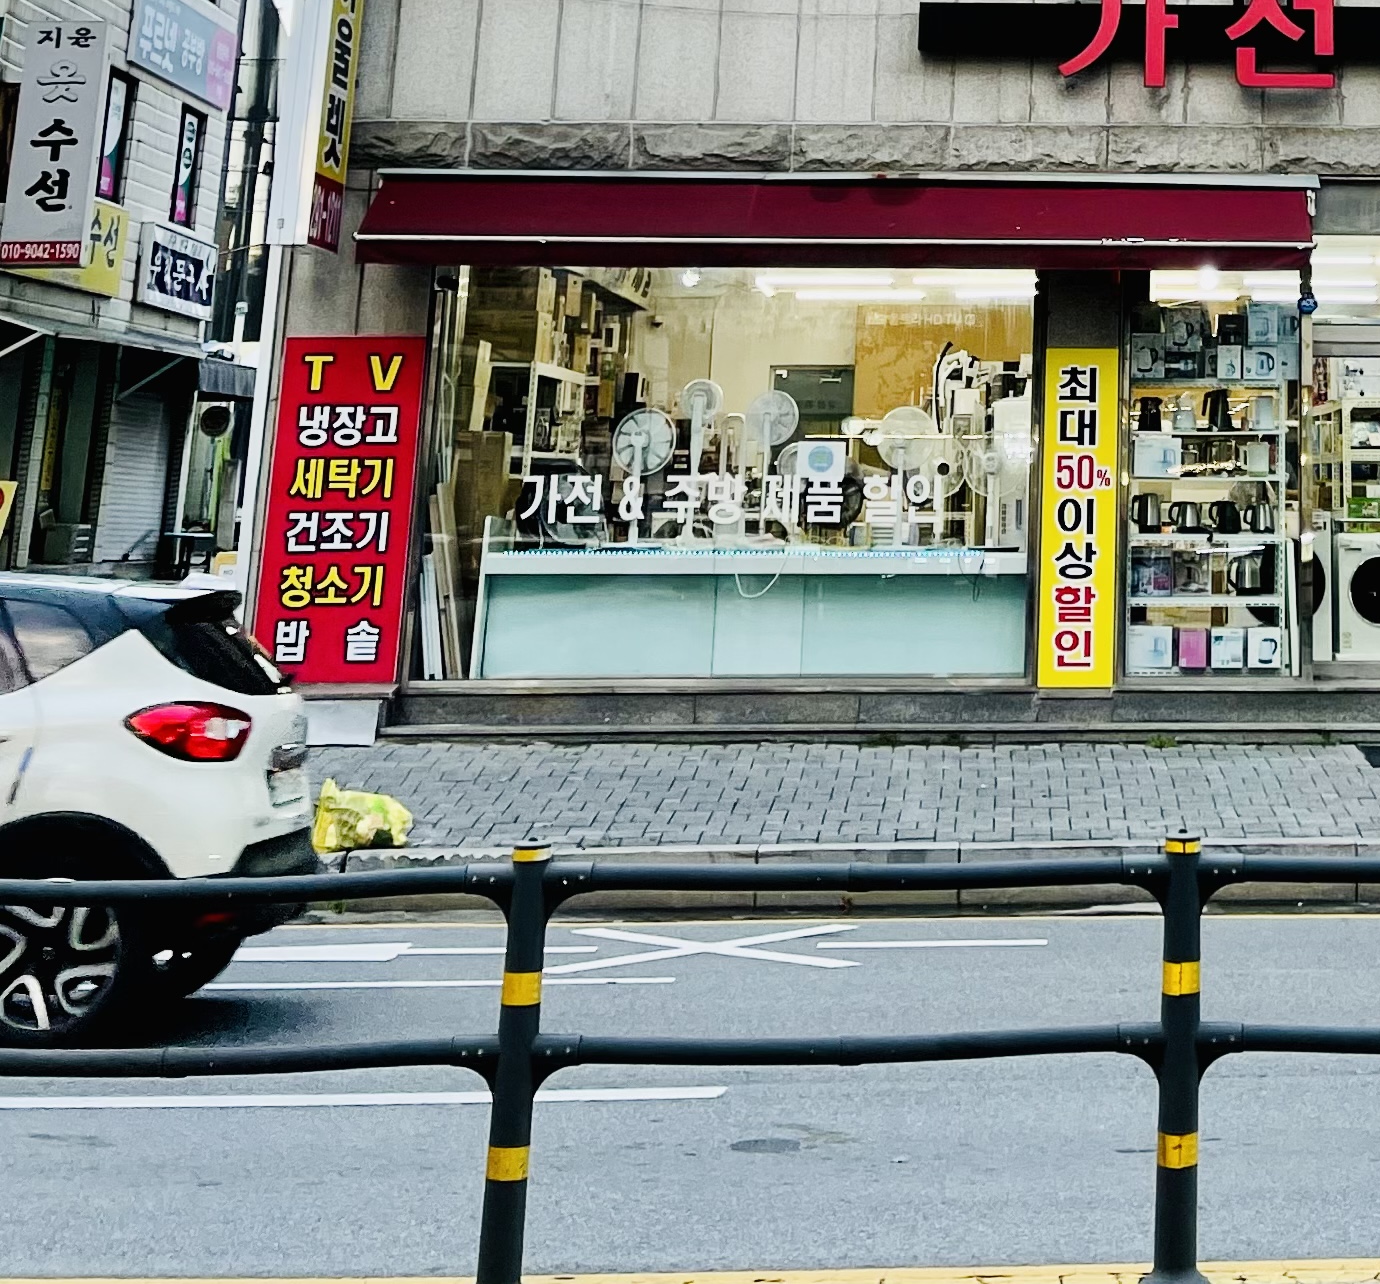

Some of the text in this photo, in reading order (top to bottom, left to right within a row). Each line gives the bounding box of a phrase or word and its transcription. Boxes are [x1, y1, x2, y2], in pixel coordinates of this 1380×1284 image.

[37, 27, 97, 49] 지윤
[1, 242, 80, 261] 010-9042-1590
[298, 406, 398, 447] 냉장고
[289, 458, 393, 500] 세탁기
[1056, 454, 1111, 490] 50%
[520, 474, 942, 524] 가전 & 주방 제품 할인
[286, 511, 389, 552] 건조기
[280, 566, 384, 607] 청소기
